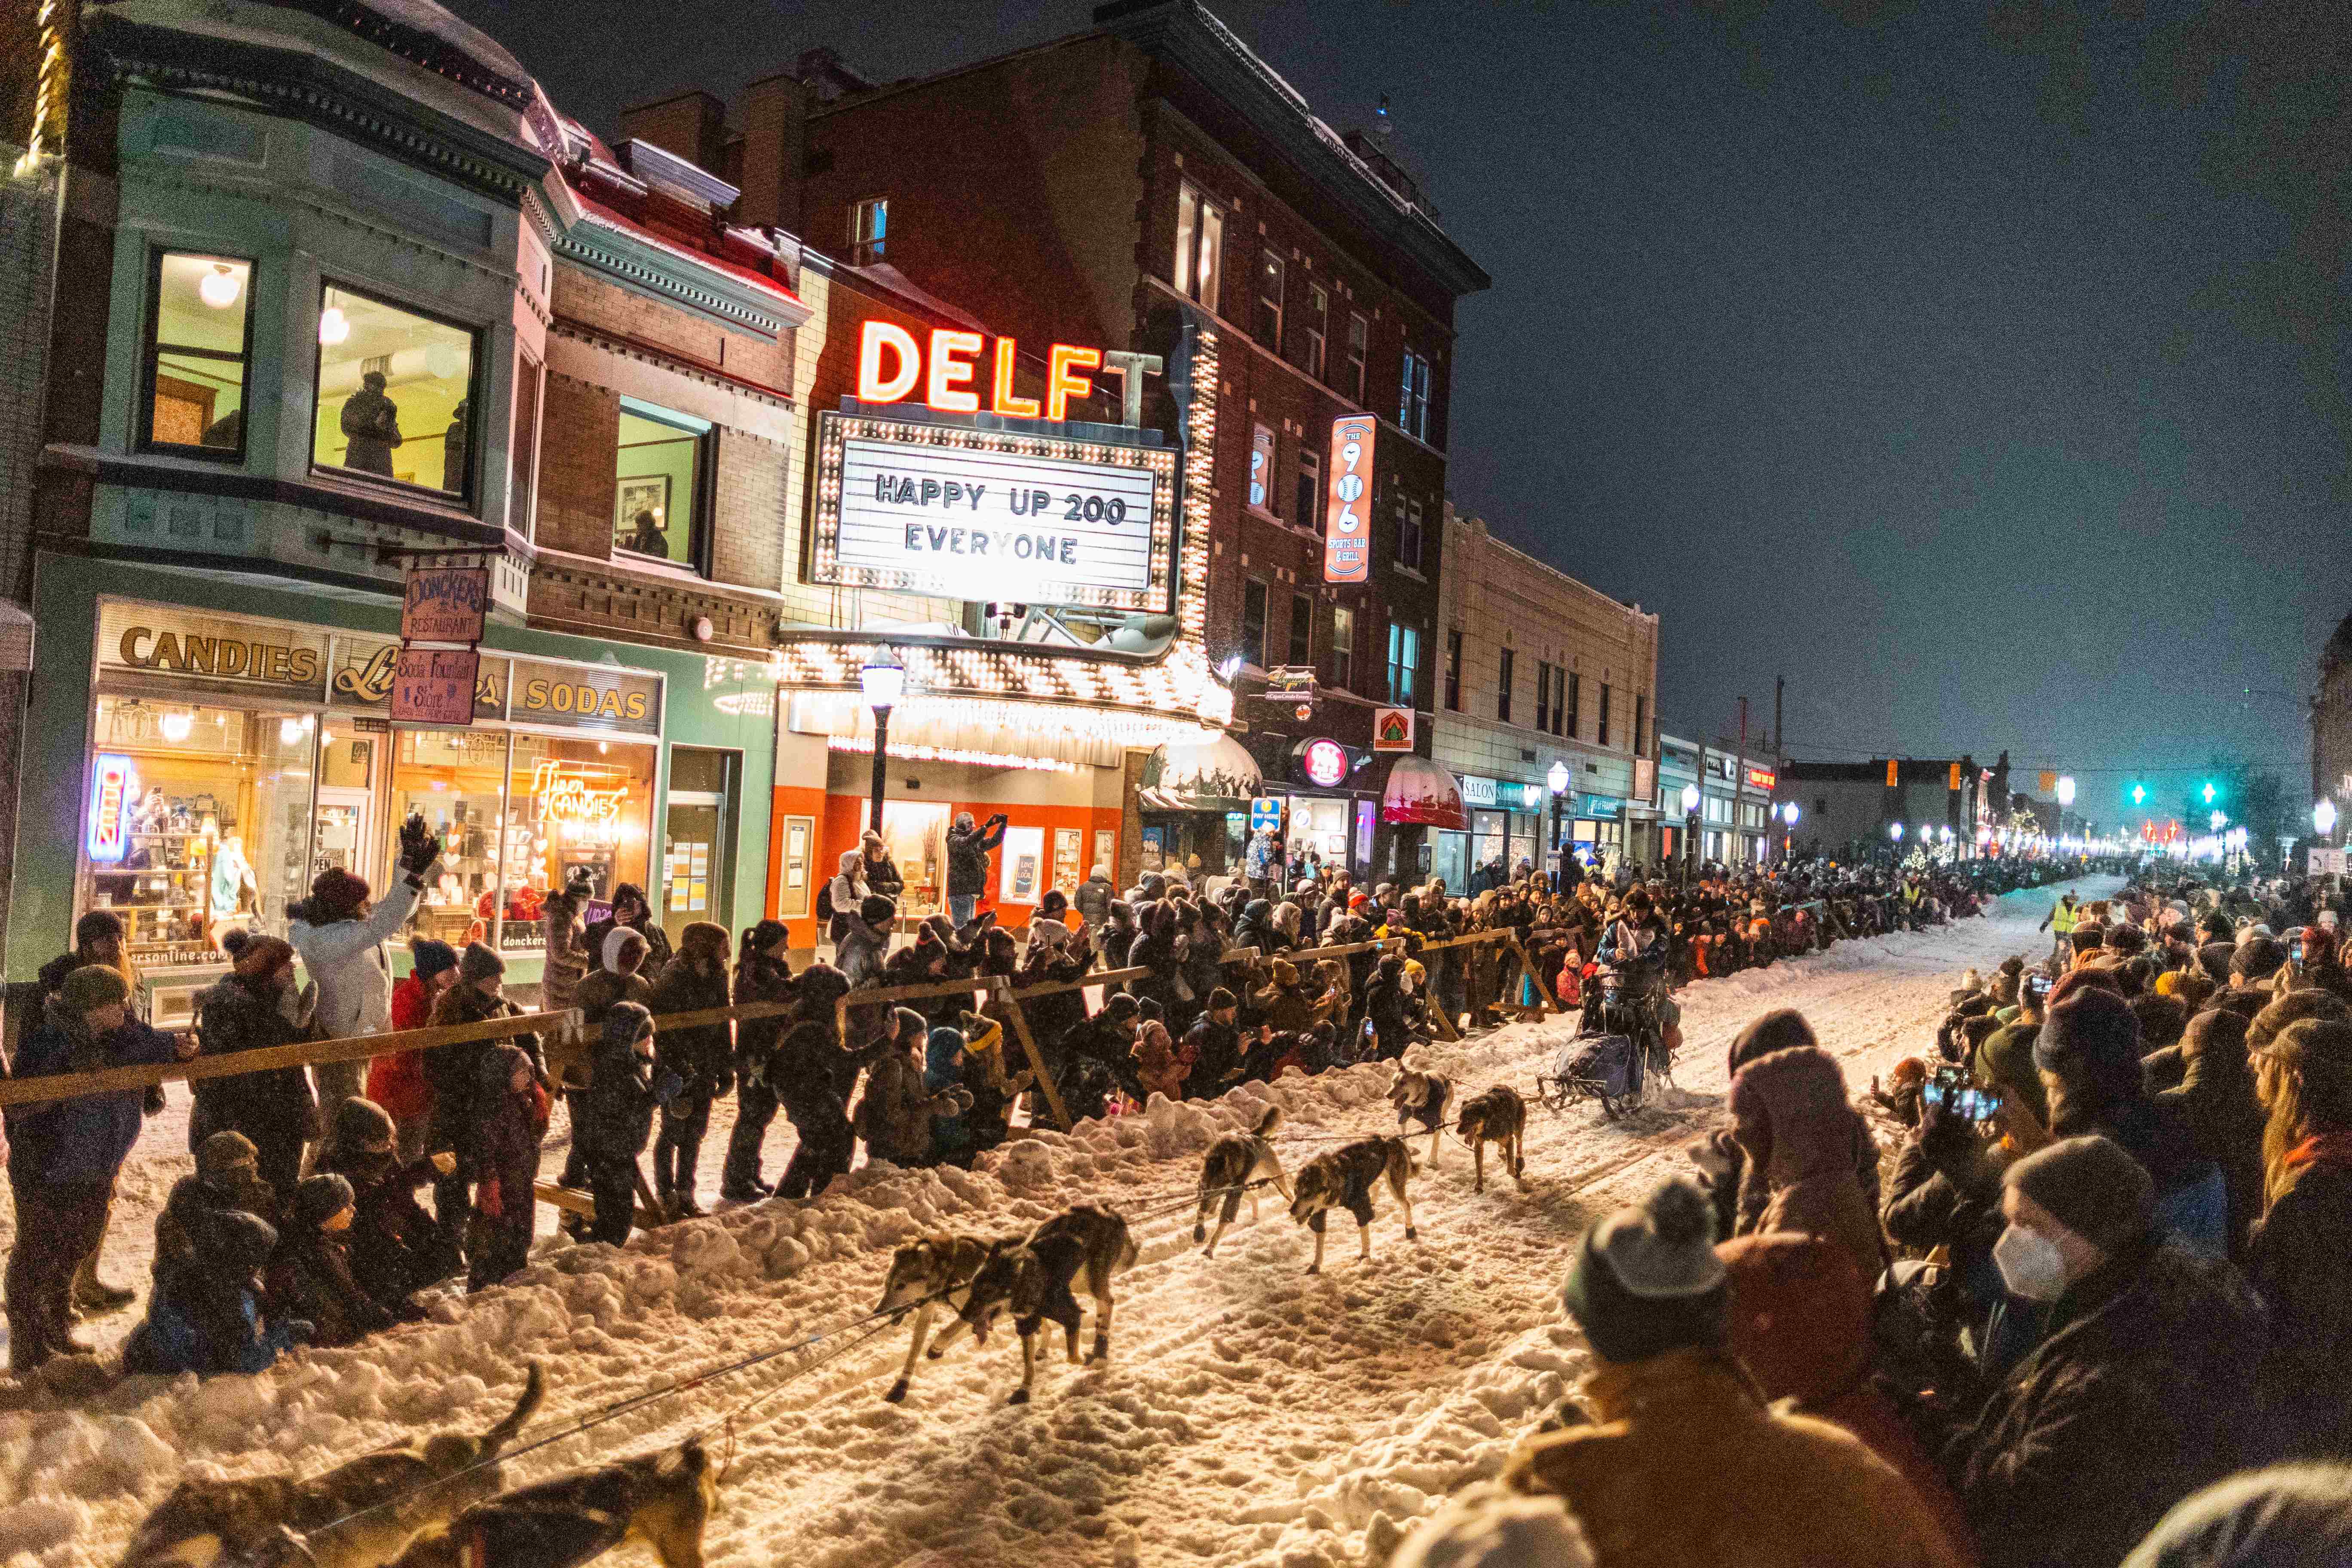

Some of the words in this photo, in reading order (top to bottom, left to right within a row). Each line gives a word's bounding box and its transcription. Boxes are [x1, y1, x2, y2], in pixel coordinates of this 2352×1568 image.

[859, 320, 1163, 428] DELFT
[1346, 432, 1360, 440] THE
[876, 473, 986, 511] HAPPY
[1010, 488, 1051, 516] UP
[1064, 494, 1127, 525] 200
[906, 523, 1078, 565] EVERYONE
[1329, 538, 1351, 549] SPORTS
[1353, 538, 1366, 548] BAR
[1342, 551, 1360, 562] GRILL
[410, 617, 472, 633] RESTAURANT
[120, 626, 317, 683] CANDIES
[527, 680, 646, 720] SODAS
[1465, 781, 1494, 799] SALON
[314, 858, 331, 871] PEN
[503, 934, 547, 947] donckers
